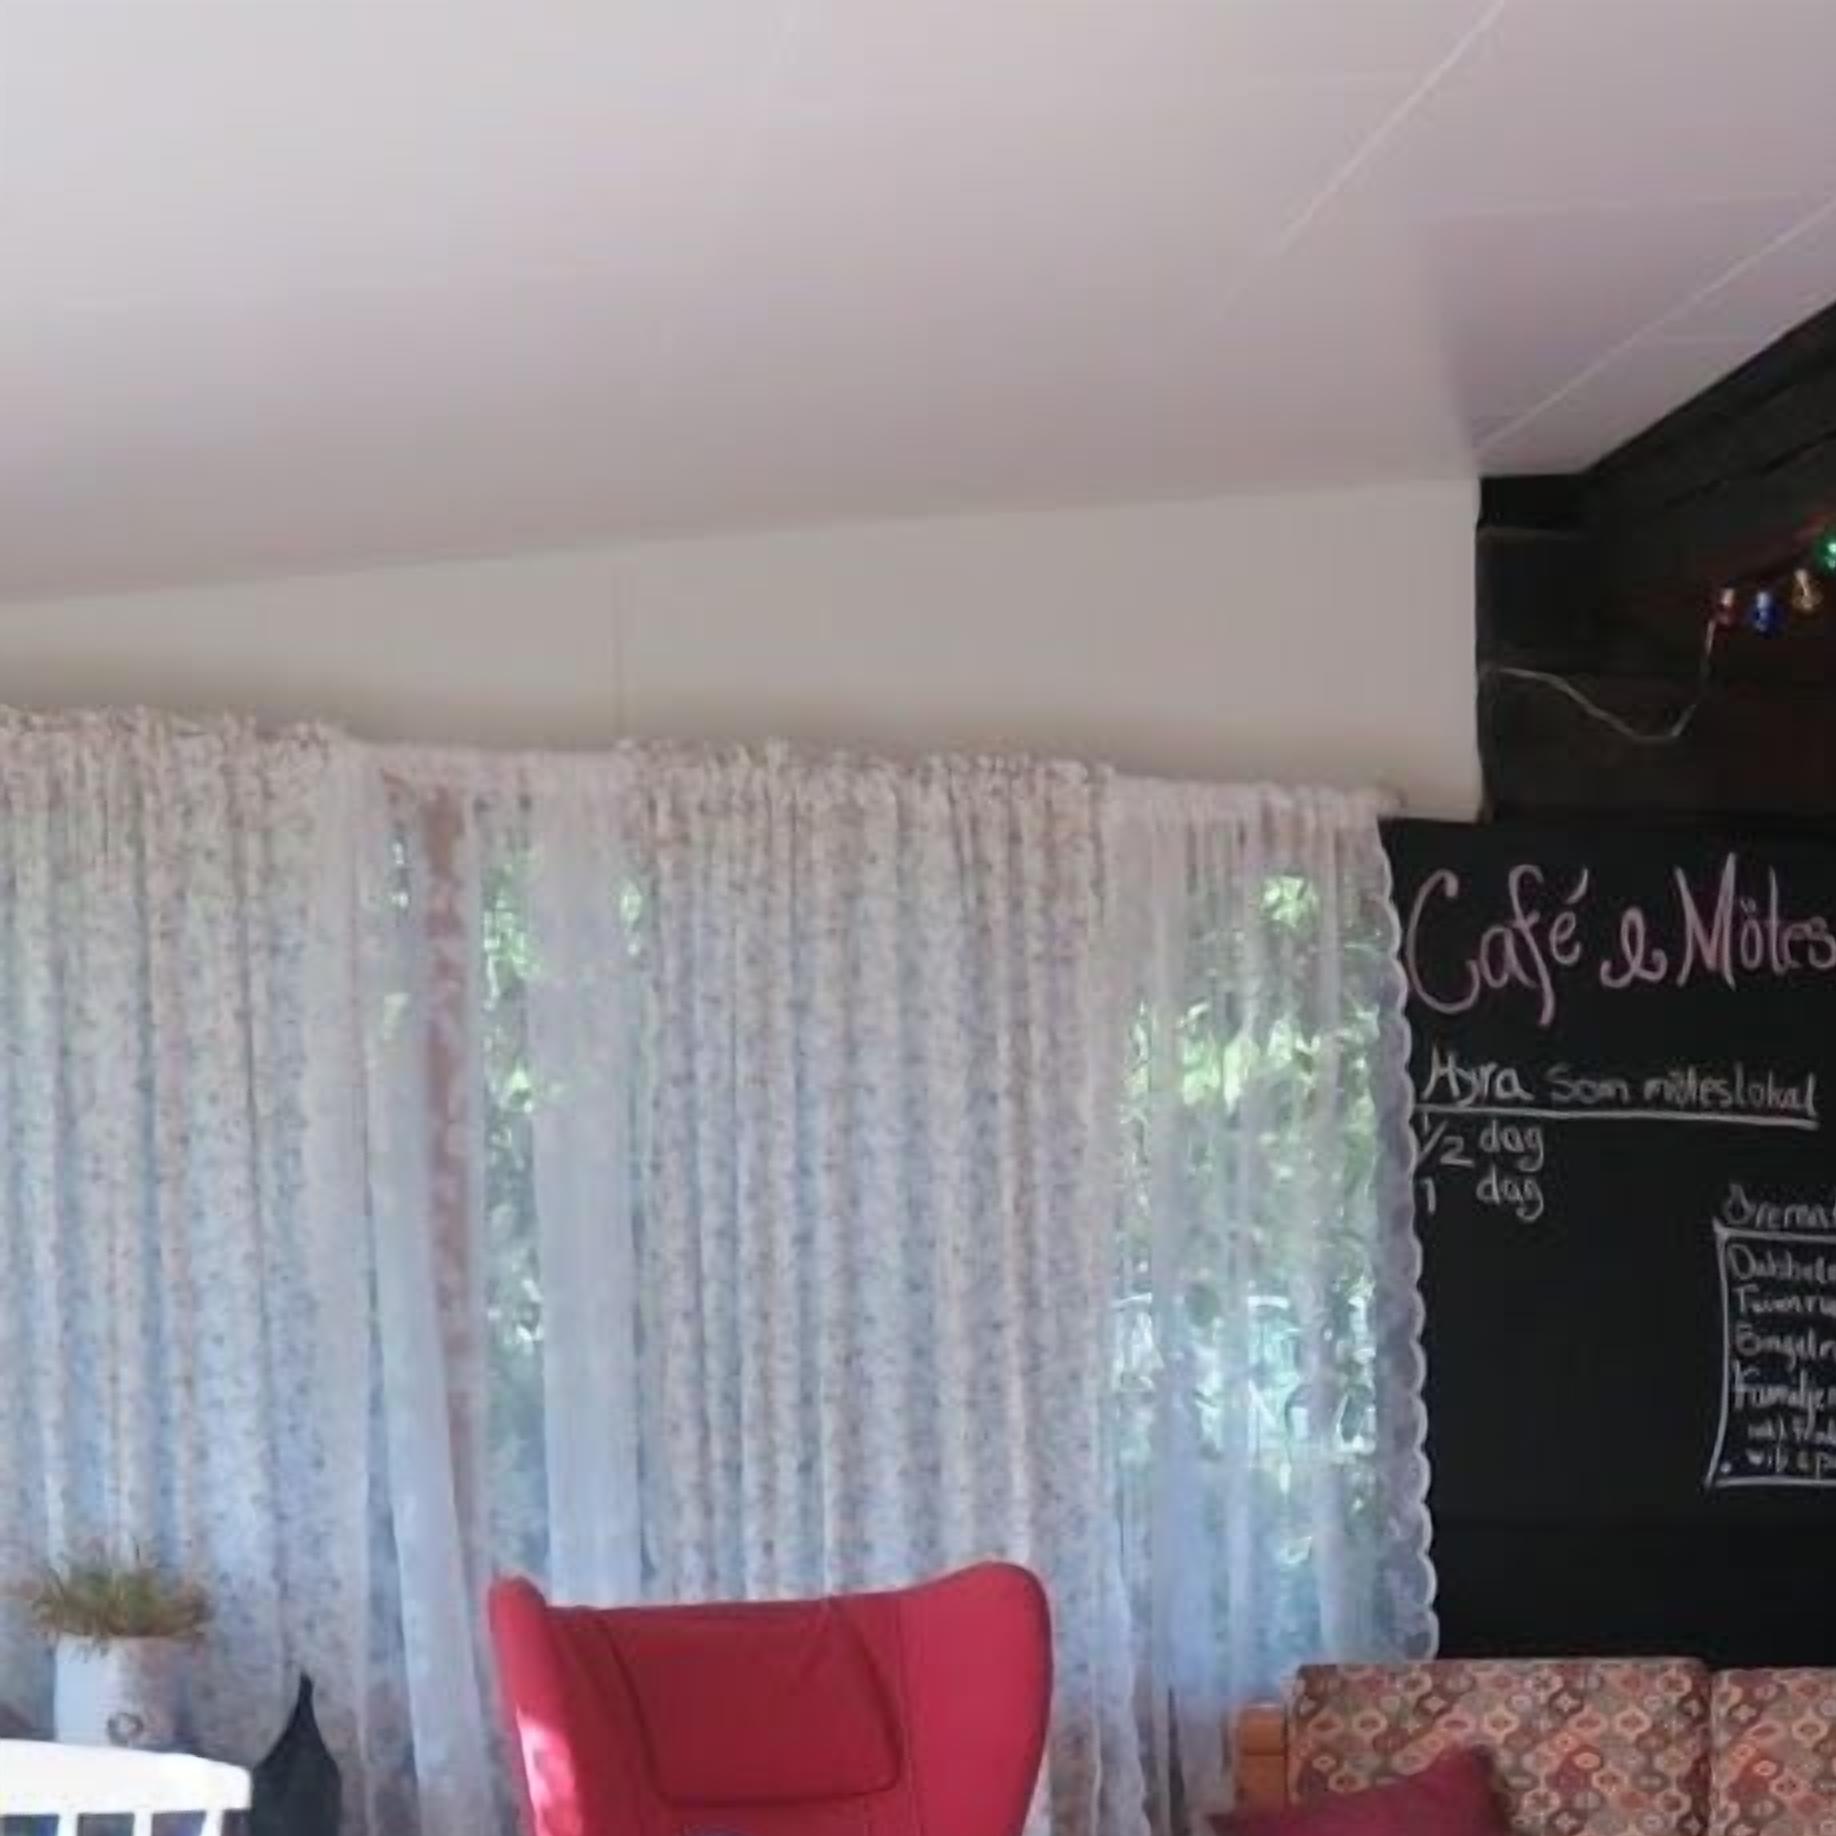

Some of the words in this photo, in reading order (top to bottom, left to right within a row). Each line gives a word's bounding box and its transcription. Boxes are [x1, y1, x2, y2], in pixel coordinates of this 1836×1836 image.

[1407, 864, 1589, 1026] Café
[1420, 1043, 1535, 1107] Hyra
[1477, 1119, 1546, 1173] dag
[1419, 1176, 1438, 1214] 1
[1475, 1164, 1546, 1223] dag
